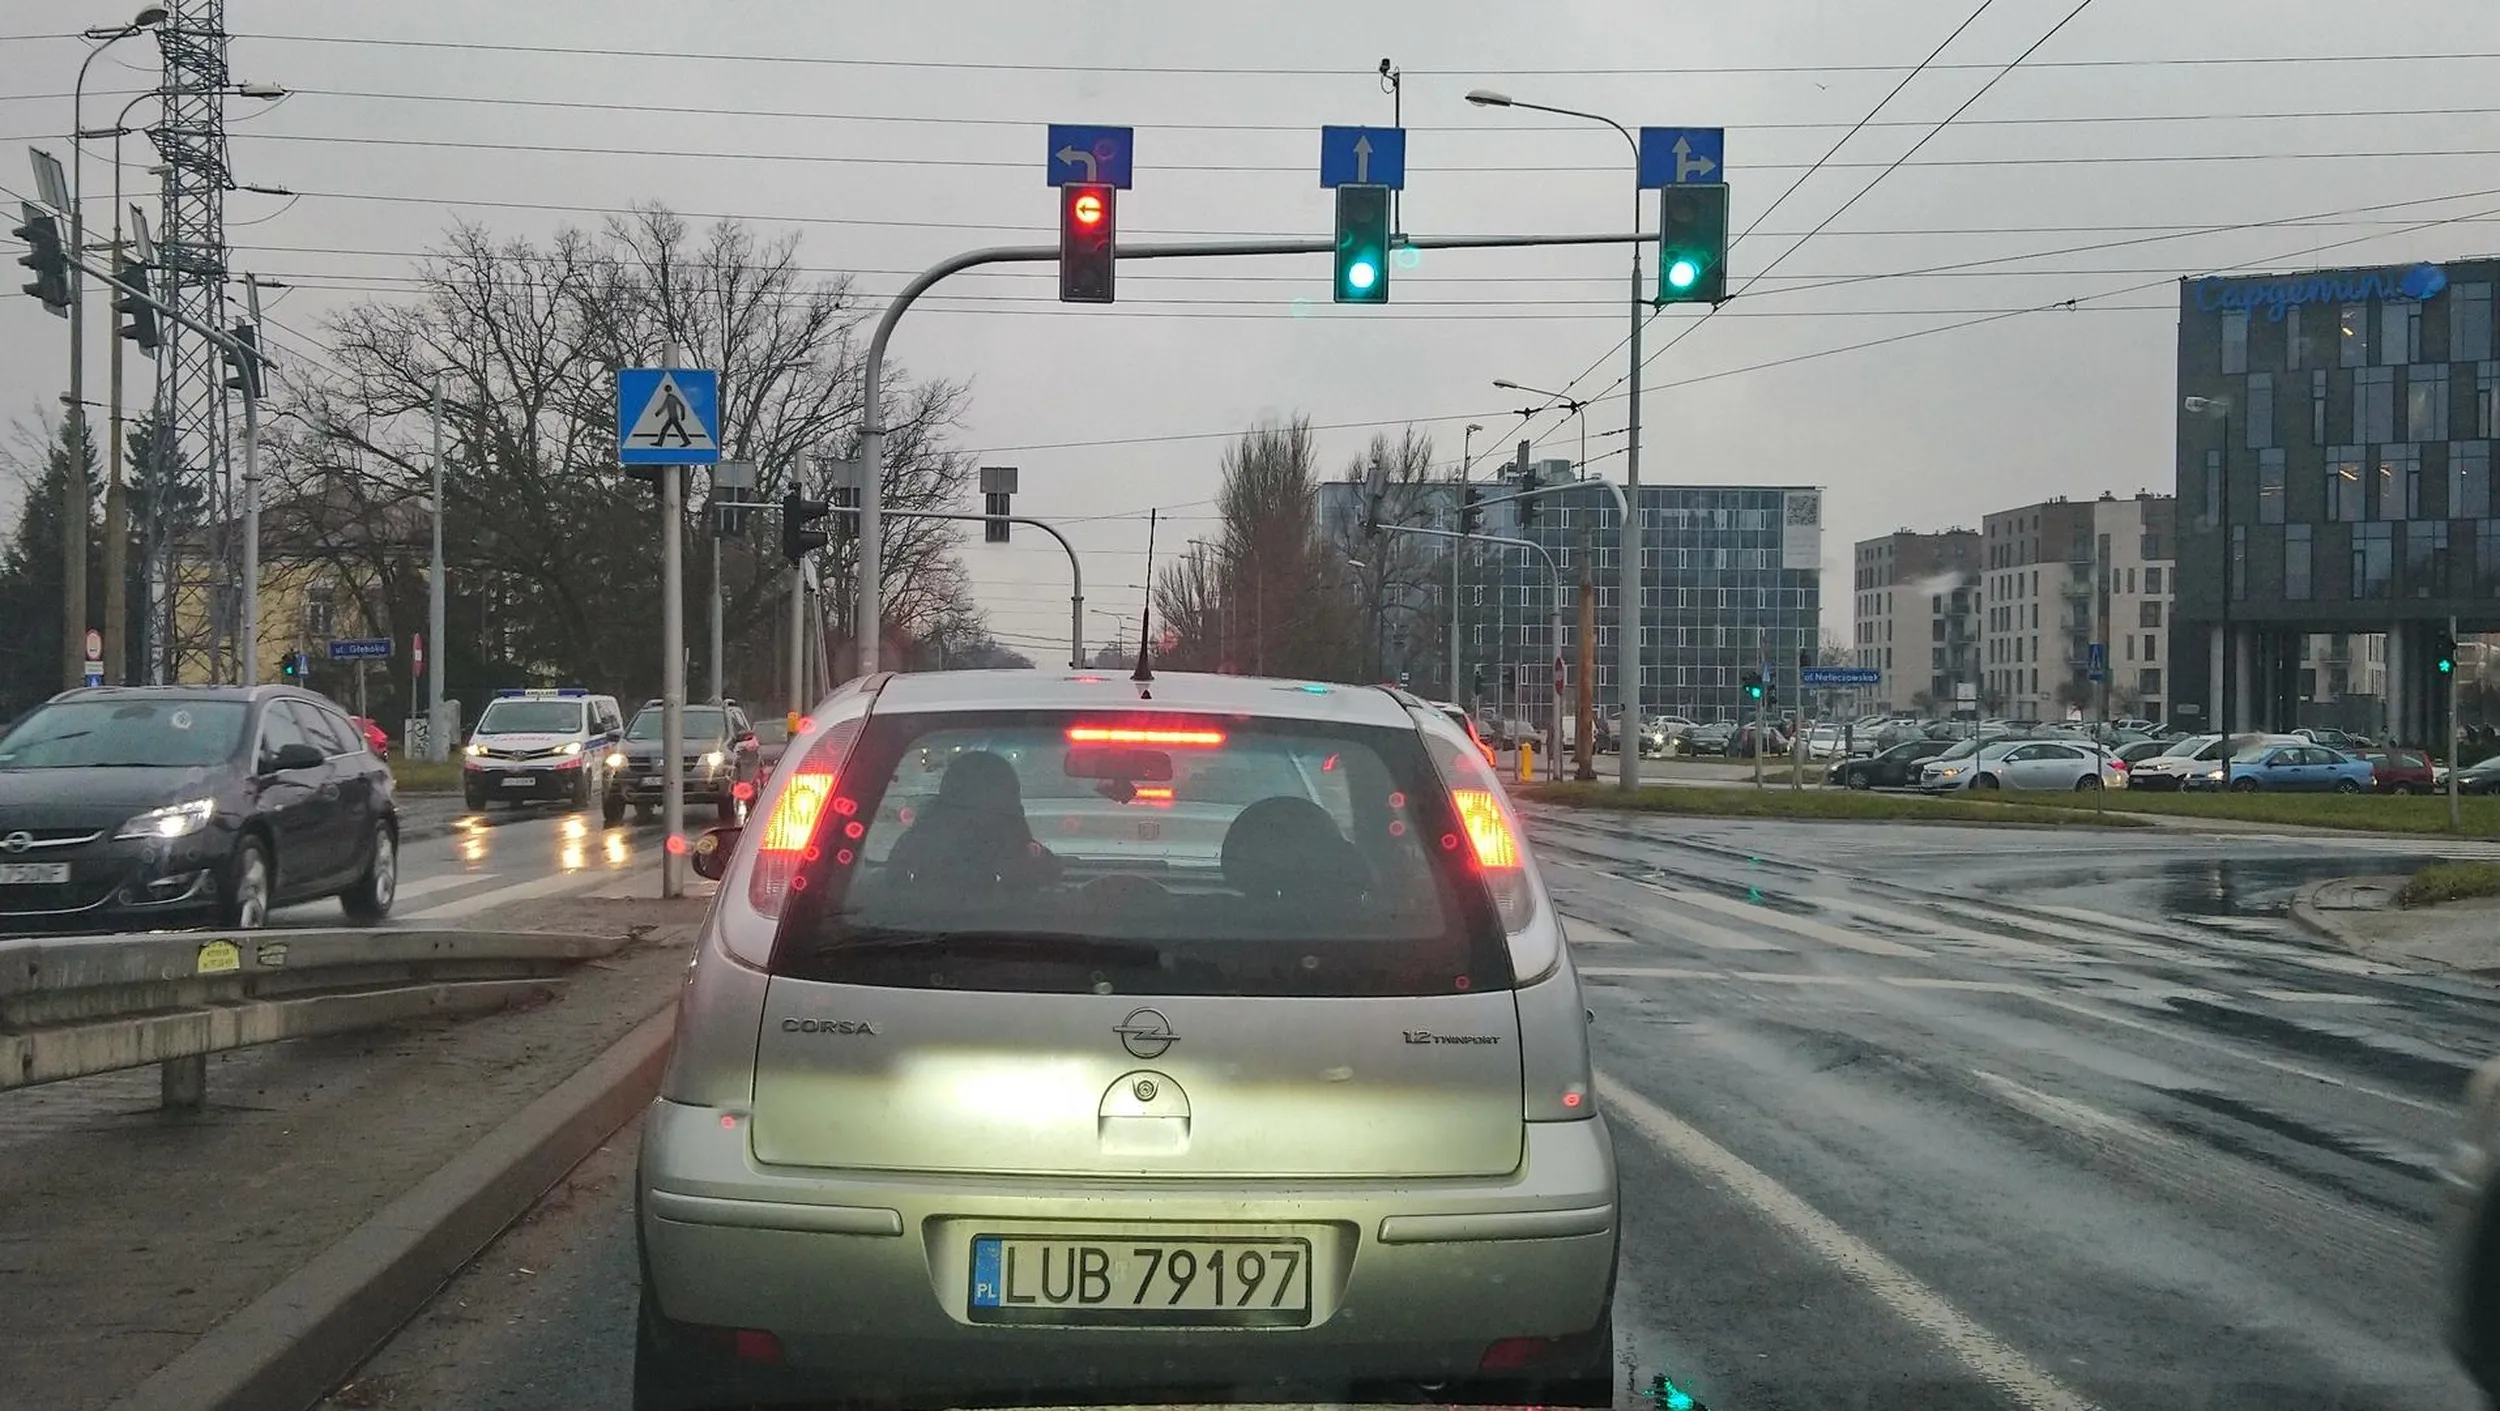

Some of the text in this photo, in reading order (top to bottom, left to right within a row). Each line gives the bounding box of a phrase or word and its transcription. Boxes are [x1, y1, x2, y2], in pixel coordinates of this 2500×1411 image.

[2195, 269, 2396, 322] Capgemini
[781, 1017, 876, 1036] CORSA
[976, 1283, 997, 1299] PL
[1005, 1246, 1300, 1307] LUB 79197
